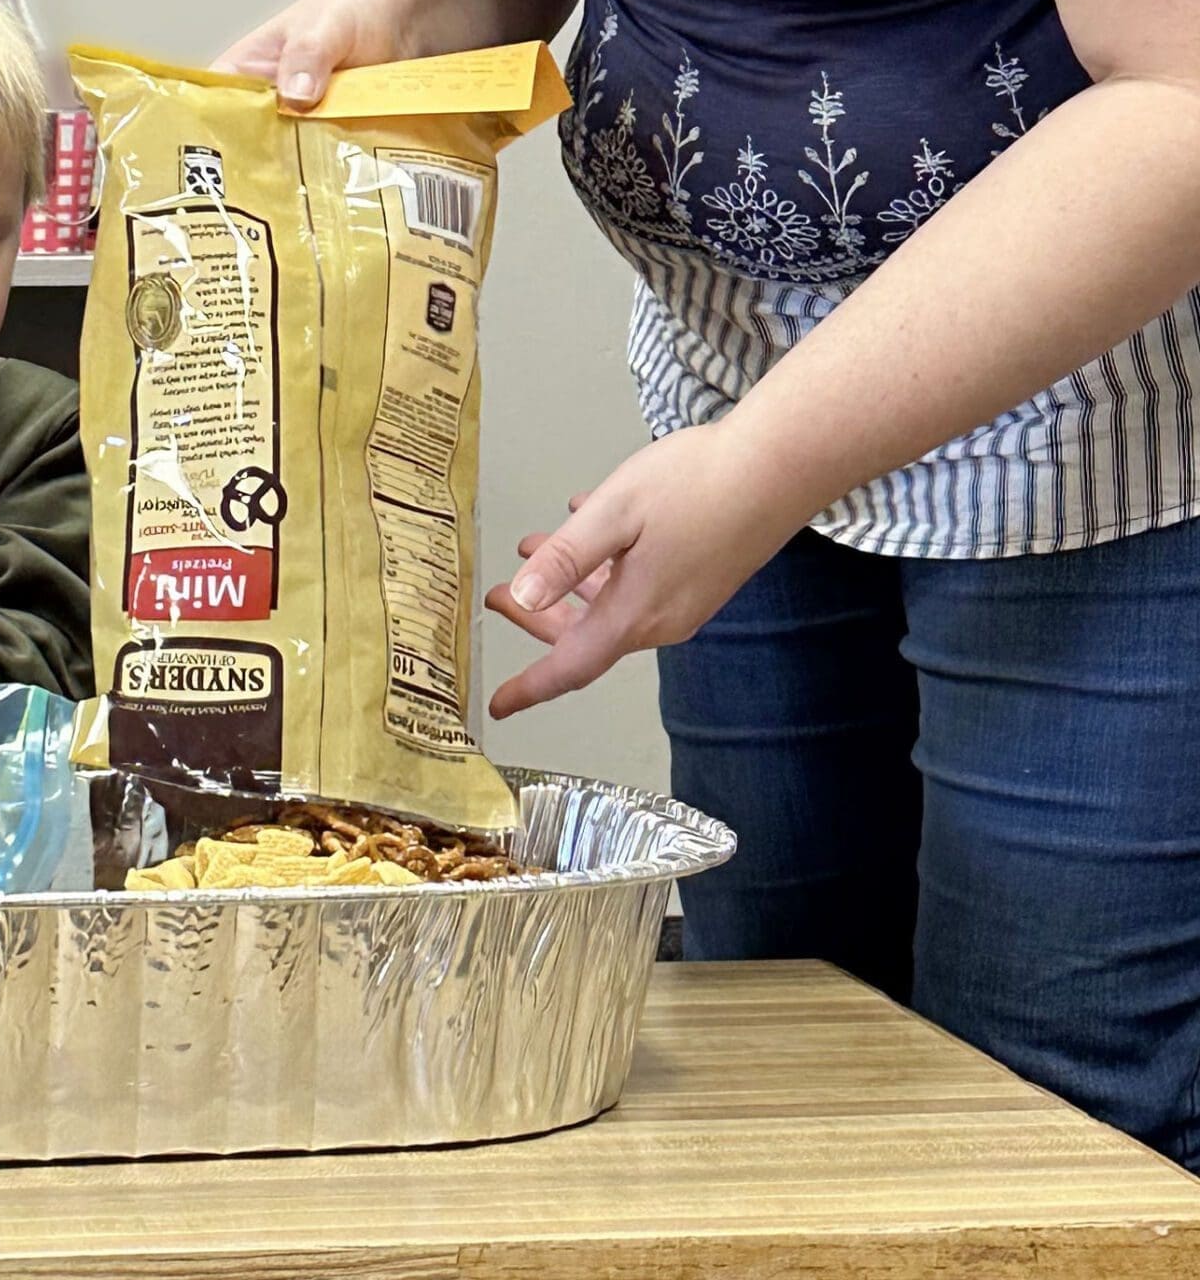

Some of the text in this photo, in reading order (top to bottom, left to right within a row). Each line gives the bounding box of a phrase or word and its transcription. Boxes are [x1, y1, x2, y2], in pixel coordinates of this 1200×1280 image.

[170, 557, 233, 573] Pretzels
[154, 573, 247, 611] Mini
[392, 654, 415, 677] 110
[127, 665, 265, 693] SNYDER'S
[416, 722, 475, 746] Nutrition
